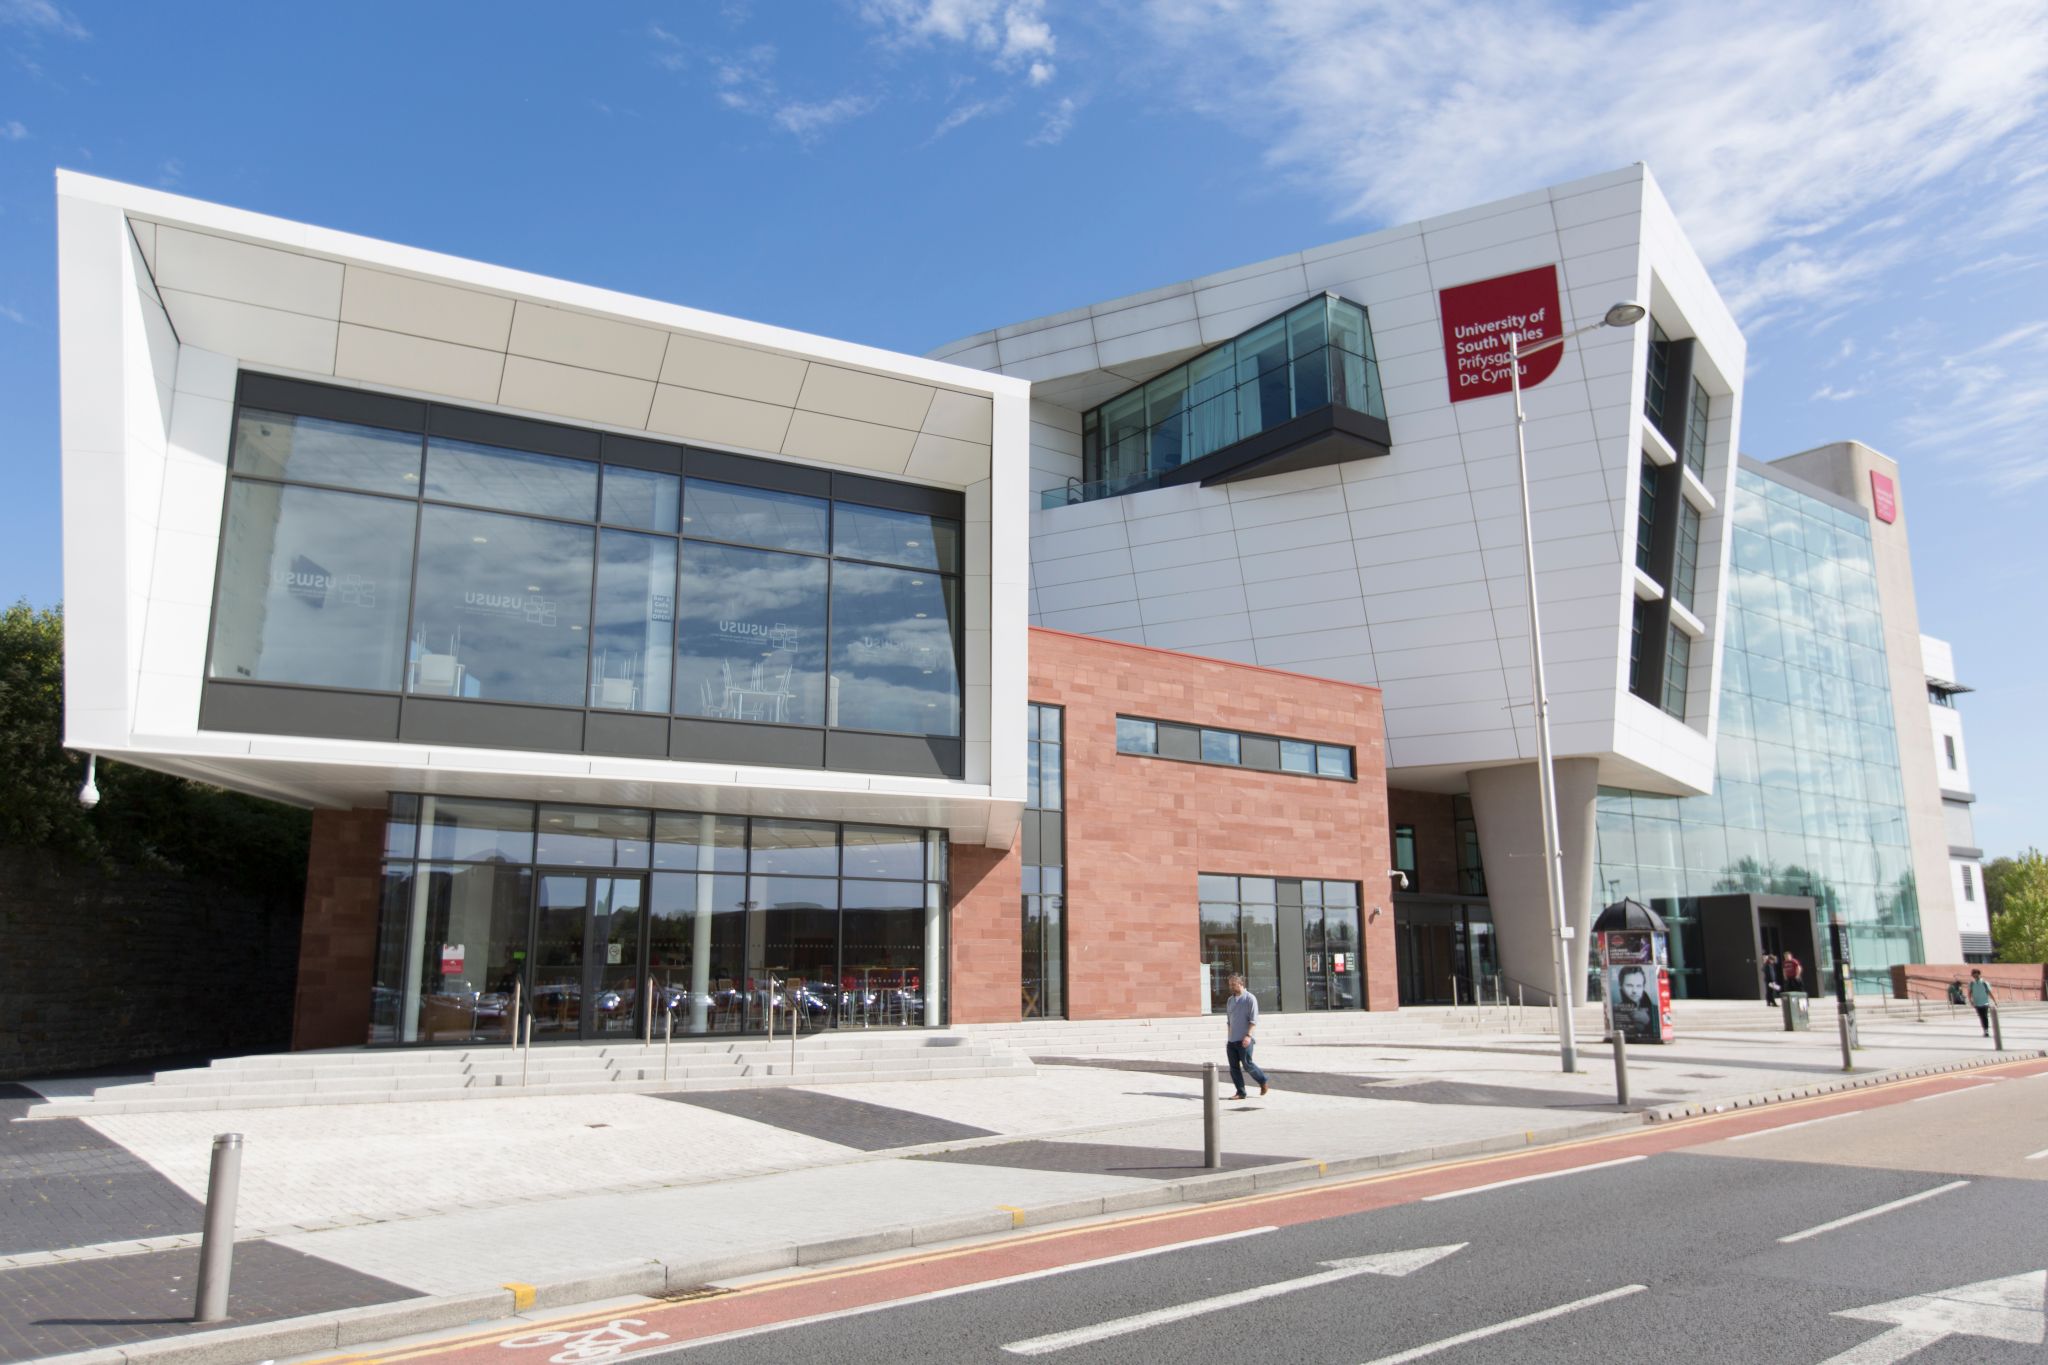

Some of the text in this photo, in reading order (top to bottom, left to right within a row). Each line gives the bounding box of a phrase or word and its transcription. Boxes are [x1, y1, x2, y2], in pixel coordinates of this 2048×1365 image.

[1455, 308, 1545, 338] University of
[1456, 337, 1498, 355] South
[1458, 350, 1517, 371] Prifysgo
[1460, 364, 1527, 387] De Cymu
